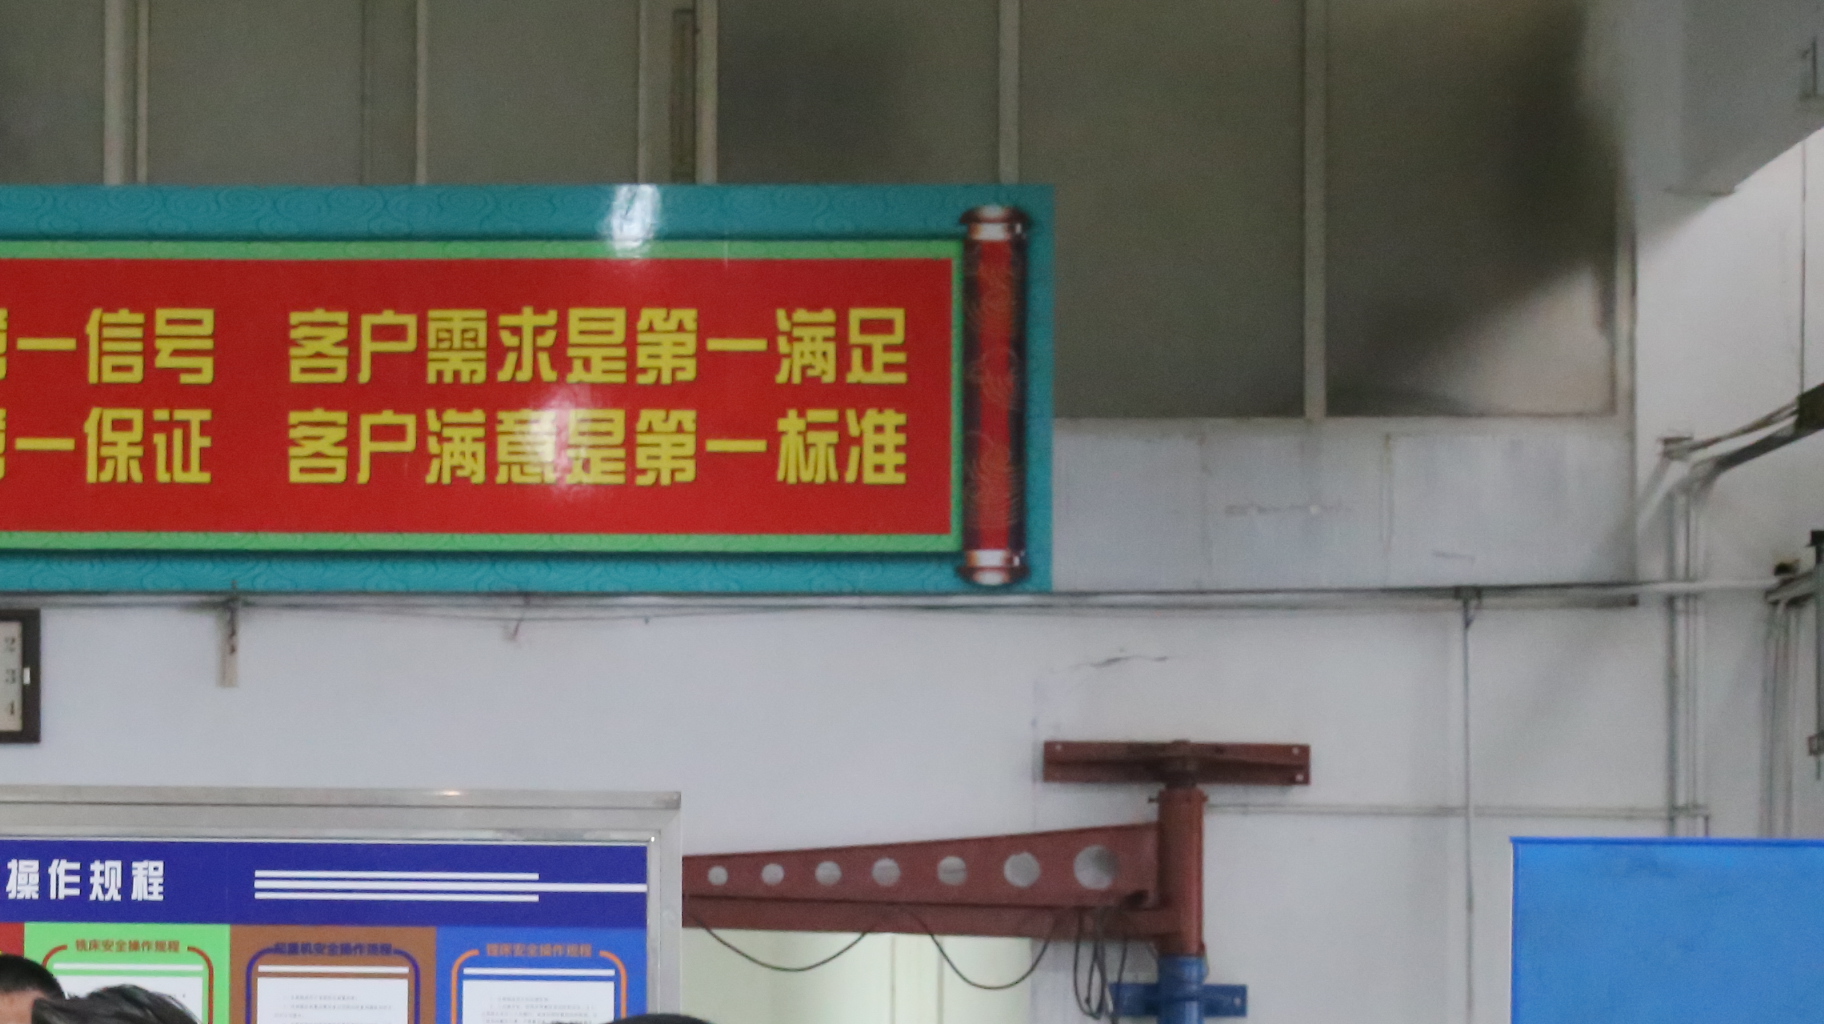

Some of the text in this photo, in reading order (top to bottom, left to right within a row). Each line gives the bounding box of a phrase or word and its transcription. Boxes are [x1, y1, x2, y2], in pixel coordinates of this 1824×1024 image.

[288, 307, 907, 385] 客户需求是第一满足
[287, 407, 907, 487] 客户满意是第一标准
